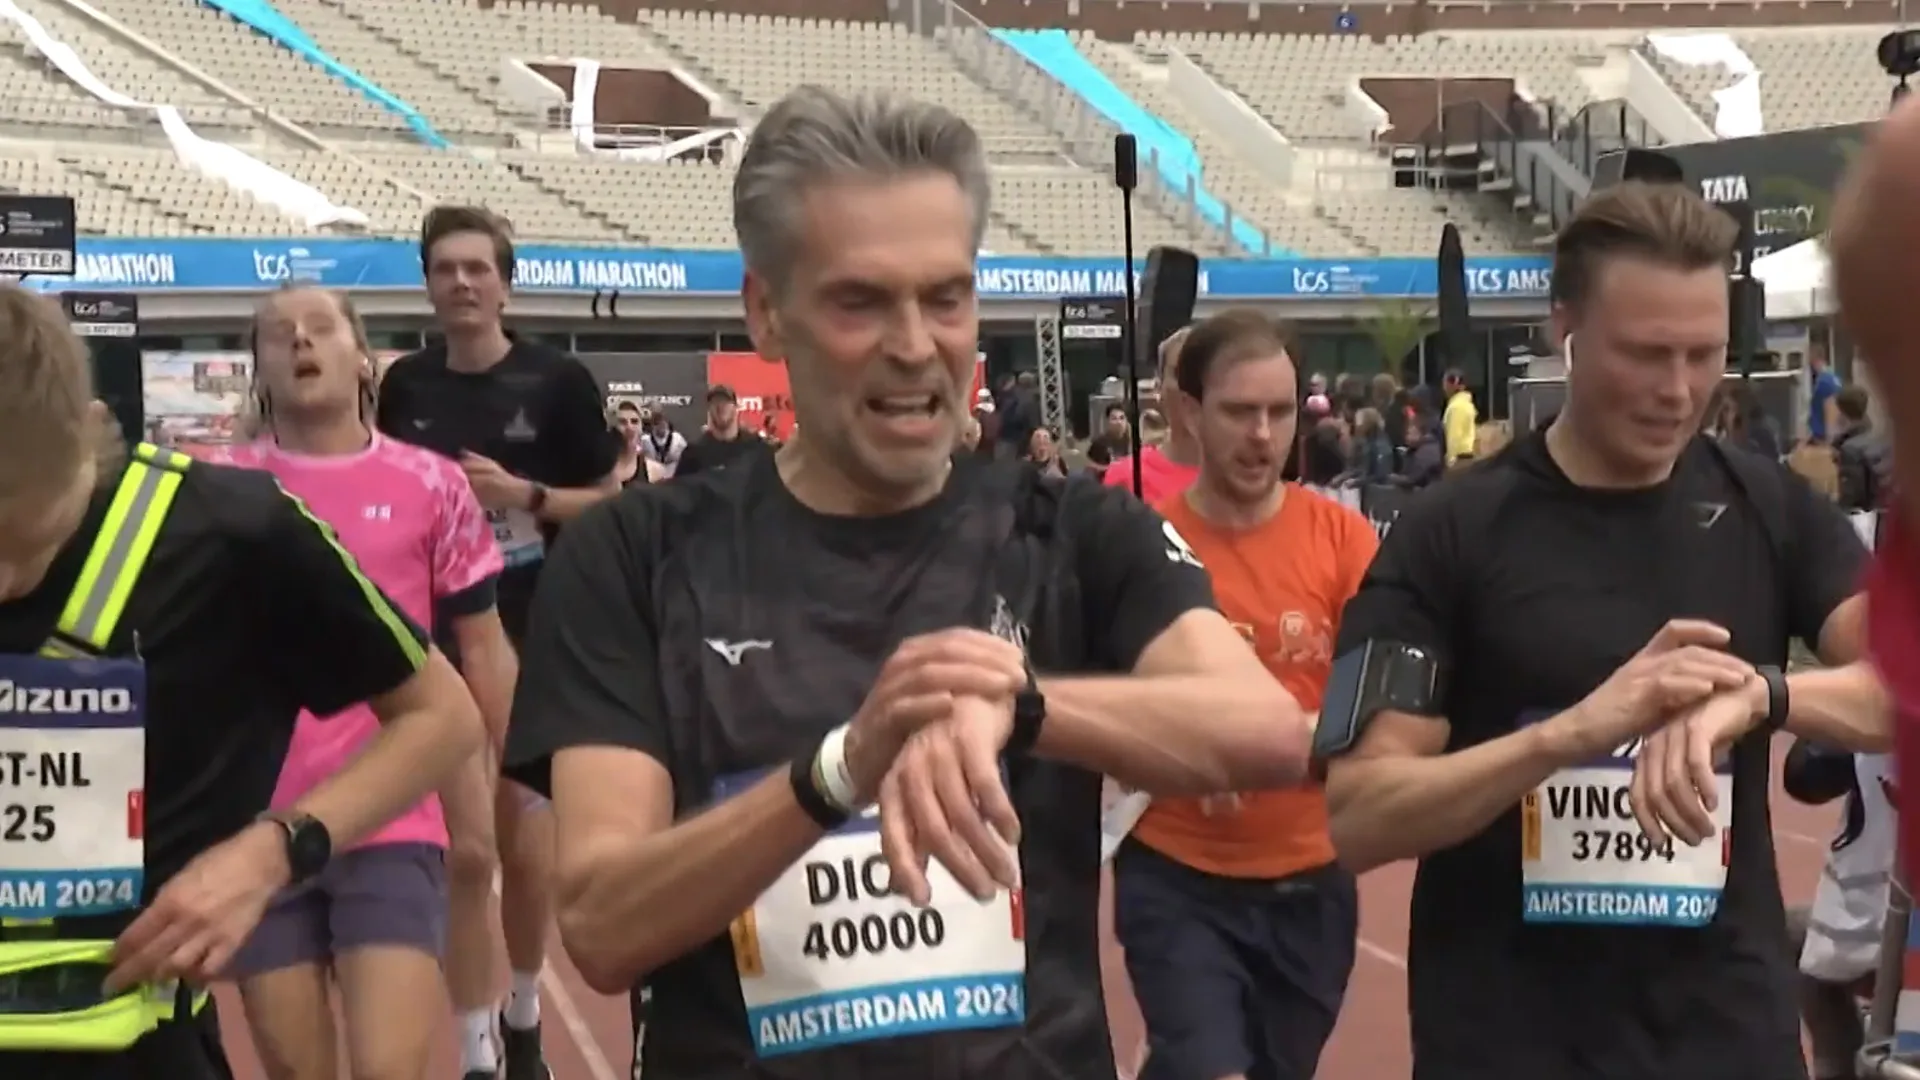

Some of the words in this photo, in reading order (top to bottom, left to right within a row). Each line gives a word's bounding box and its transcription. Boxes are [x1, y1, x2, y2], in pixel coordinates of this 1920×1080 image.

[1701, 174, 1749, 202] TATA
[578, 259, 687, 288] MARATHON
[1293, 267, 1329, 292] tcs
[1465, 267, 1502, 292] TCS
[1547, 785, 1634, 820] VINC
[1571, 830, 1676, 863] 37894
[55, 877, 134, 908] 2024
[804, 852, 894, 906] DIC
[1526, 890, 1669, 918] AMSTERDAM
[803, 906, 946, 961] 40000
[758, 989, 947, 1048] AMSTERDAM
